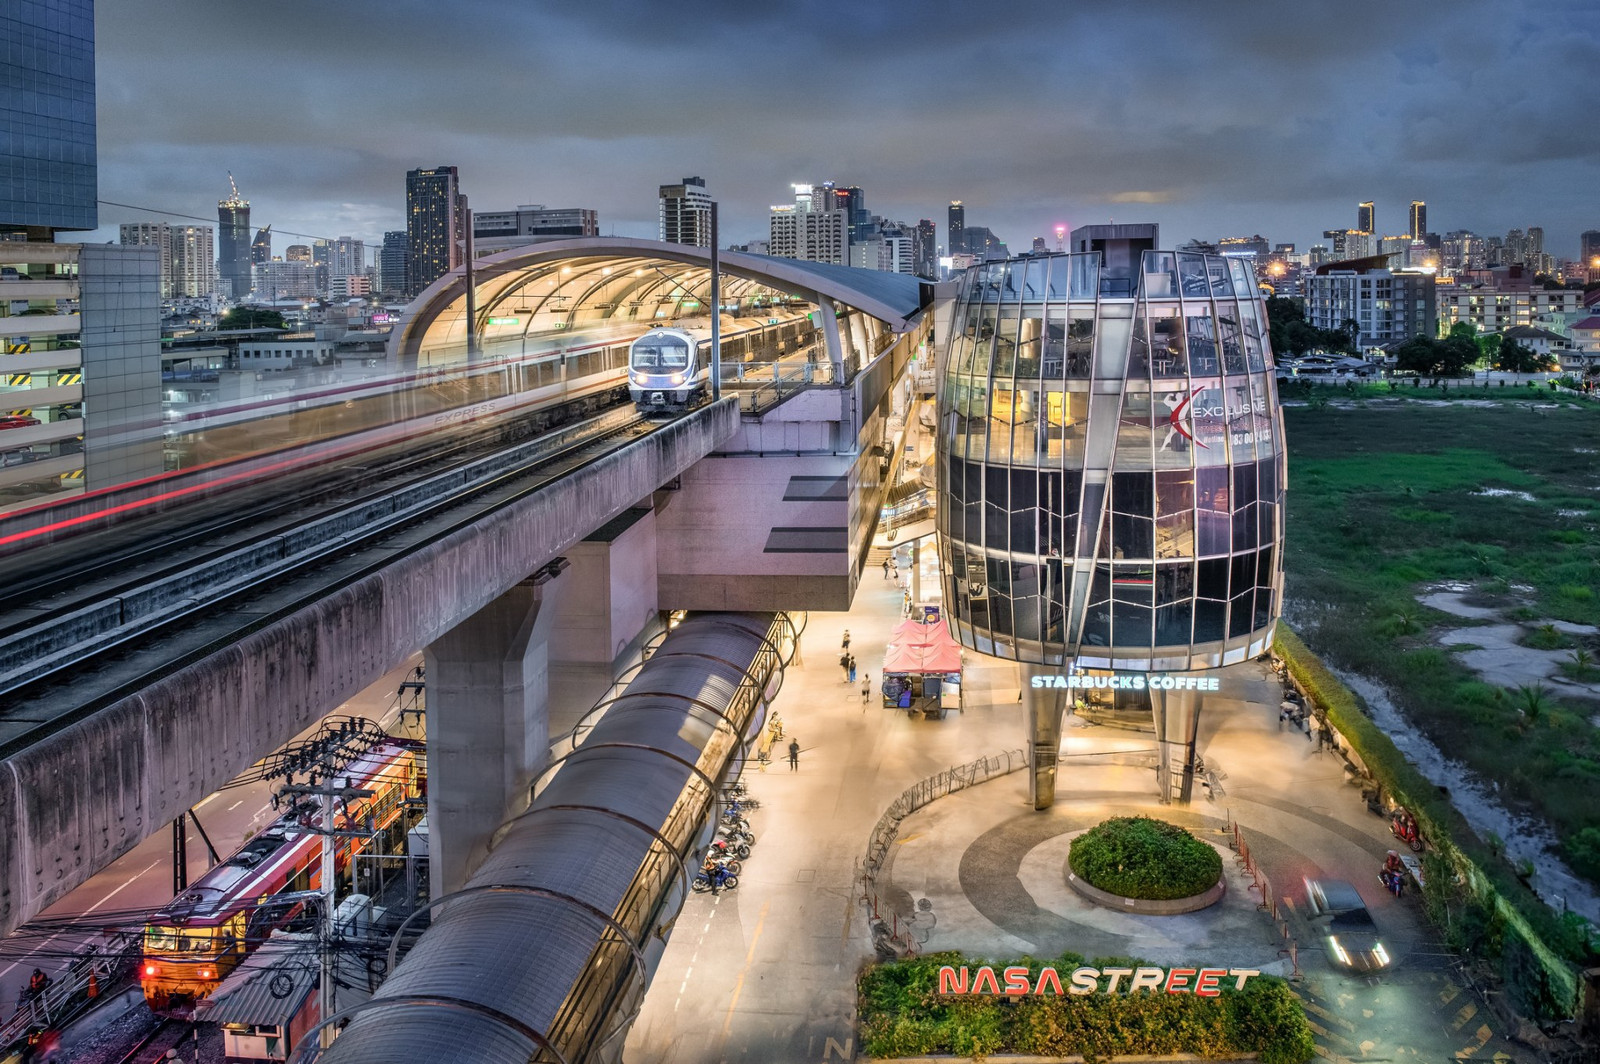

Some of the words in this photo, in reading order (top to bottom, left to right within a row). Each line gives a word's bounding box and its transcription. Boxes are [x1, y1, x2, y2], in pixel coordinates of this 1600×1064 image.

[434, 402, 496, 424] EXPRESS
[1193, 400, 1266, 418] EXCLUSVE
[1031, 675, 1146, 690] STARBUCKS
[1149, 676, 1220, 691] COFFEE
[939, 965, 1064, 995] NASA
[1067, 966, 1261, 998] STREET
